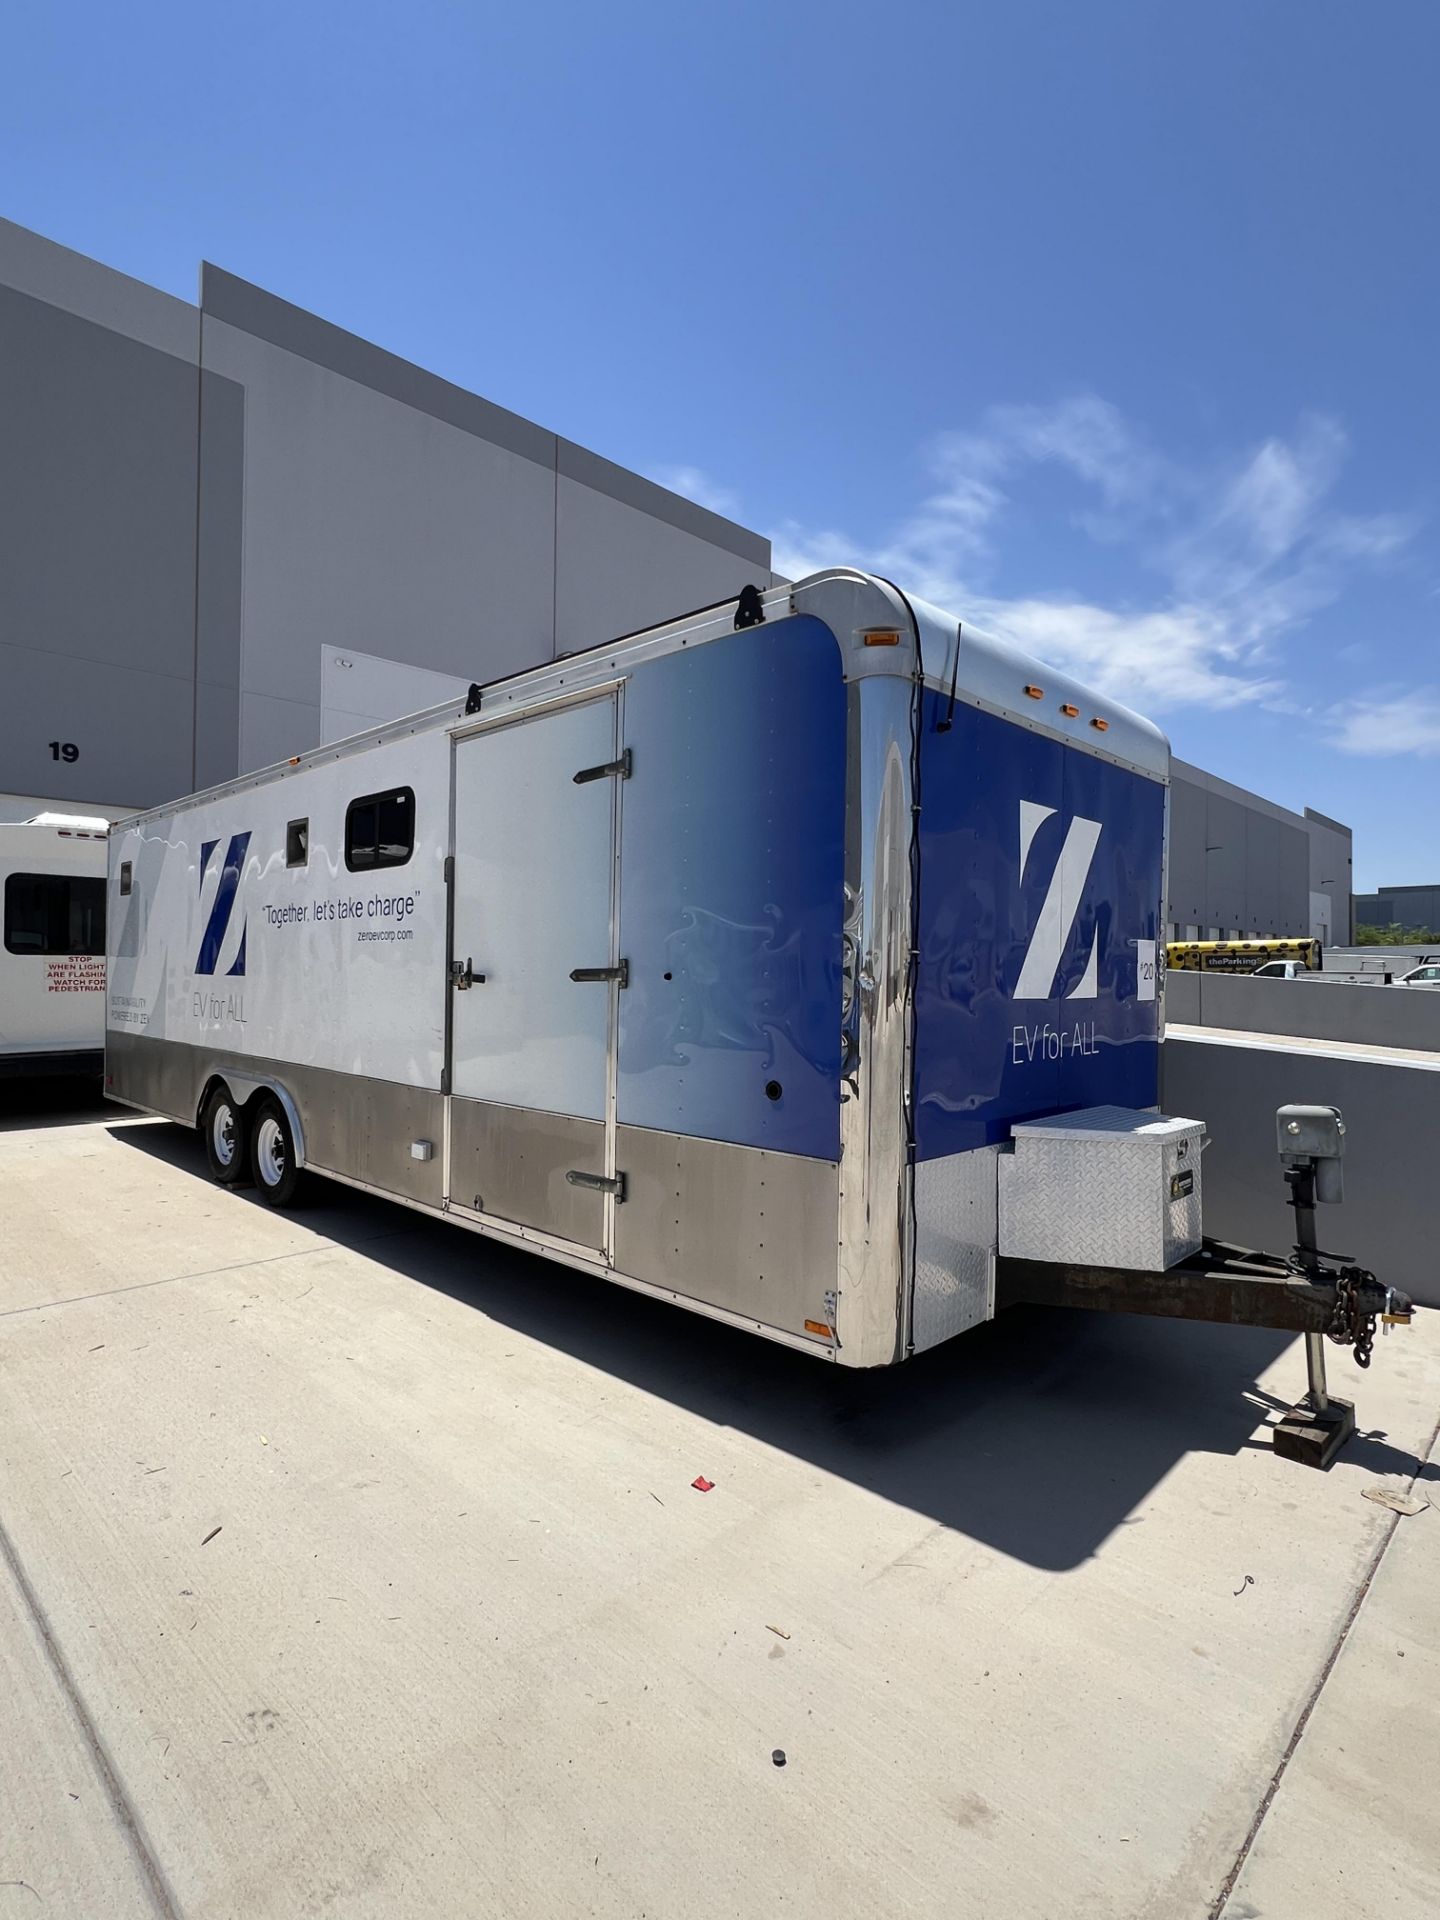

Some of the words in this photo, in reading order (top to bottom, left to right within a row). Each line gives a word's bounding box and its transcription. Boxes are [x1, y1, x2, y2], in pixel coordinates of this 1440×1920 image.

[49, 741, 79, 763] 19
[313, 900, 335, 921] let's
[337, 897, 364, 920] take
[357, 928, 414, 943] zeroevcorpcom
[193, 991, 208, 1017] EV
[210, 992, 226, 1019] for
[227, 994, 247, 1023] ALL
[1012, 1025, 1038, 1064] EV
[1043, 1023, 1068, 1060] for
[1071, 1021, 1099, 1057] ALL
